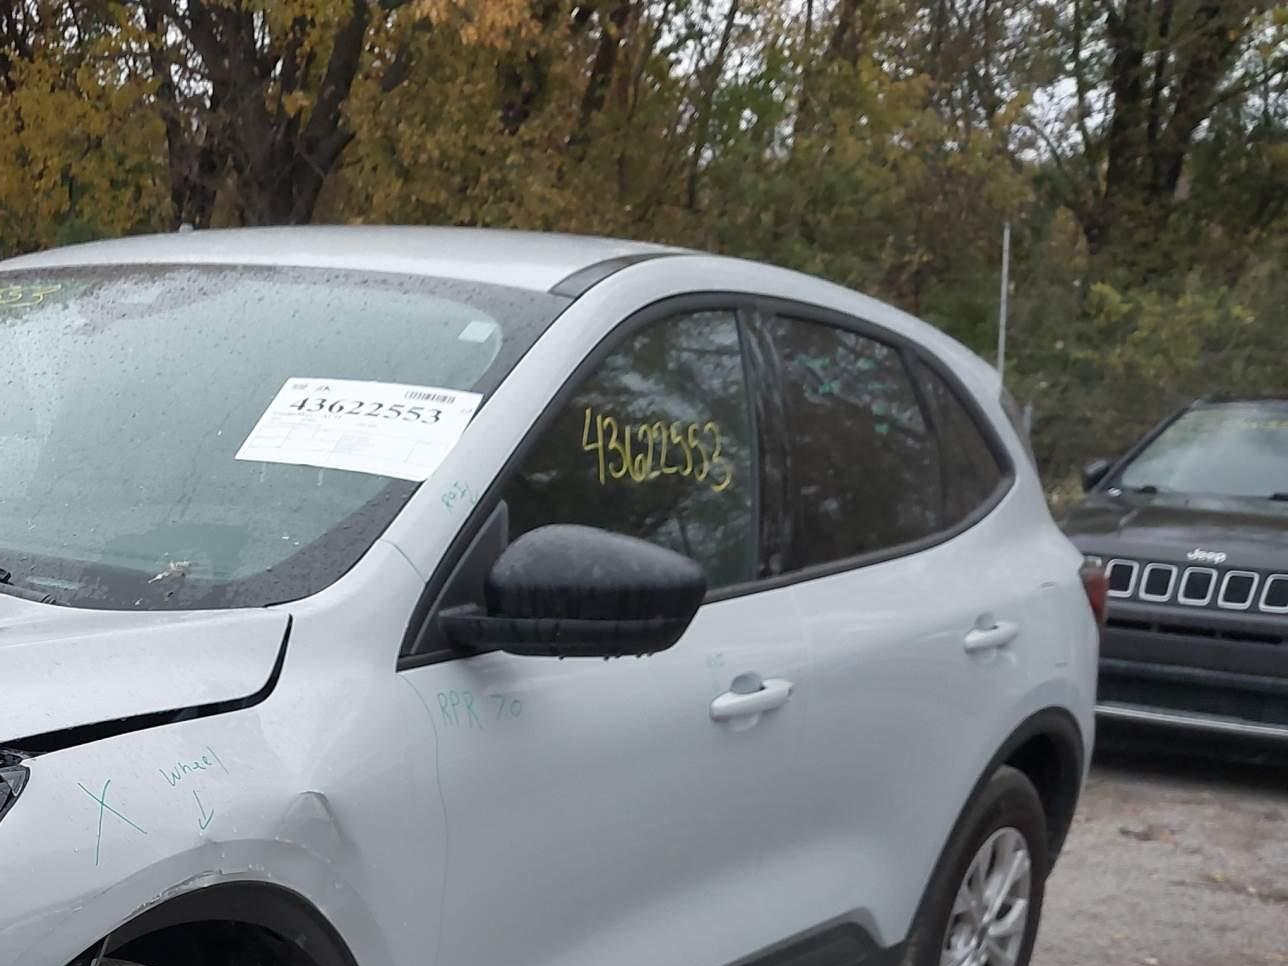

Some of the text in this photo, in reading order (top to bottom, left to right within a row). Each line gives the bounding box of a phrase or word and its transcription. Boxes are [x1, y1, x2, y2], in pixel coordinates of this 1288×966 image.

[289, 396, 443, 425] 43622553
[582, 407, 735, 493] 43622553
[1187, 548, 1227, 564] Jeep
